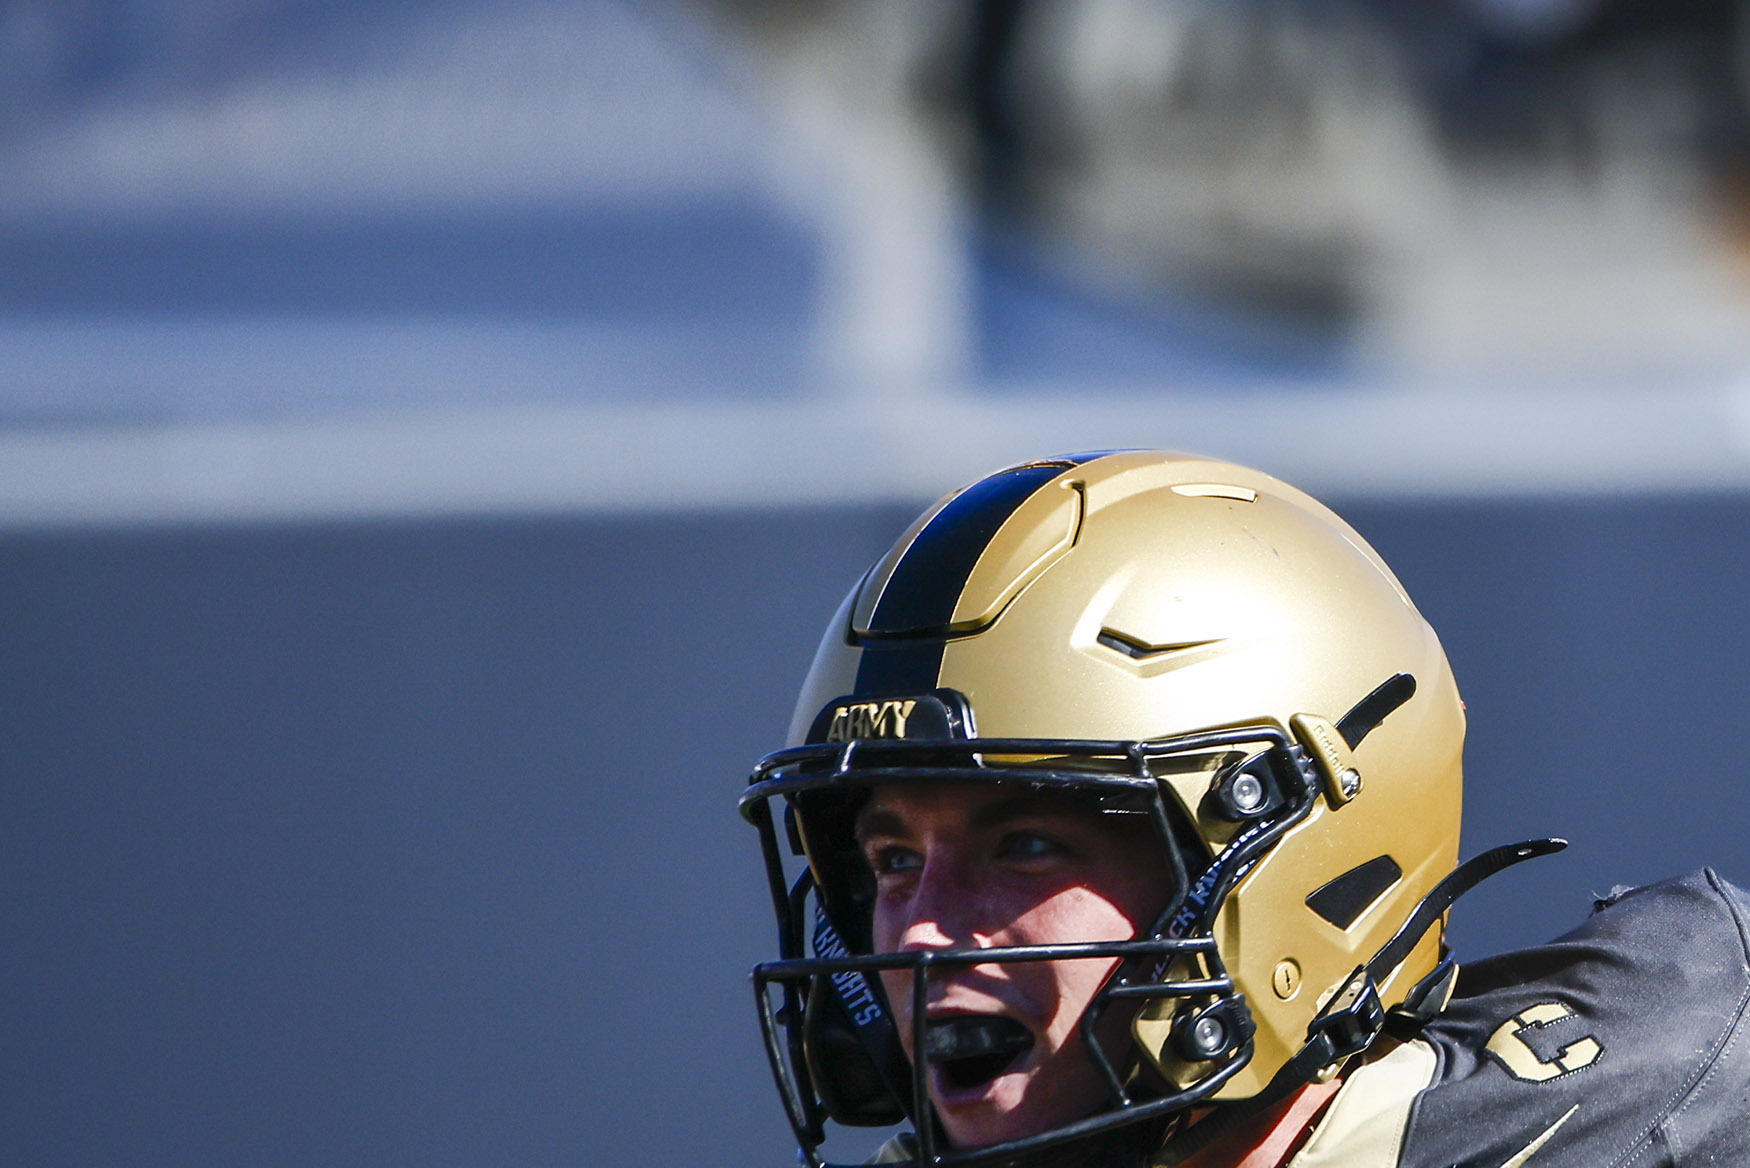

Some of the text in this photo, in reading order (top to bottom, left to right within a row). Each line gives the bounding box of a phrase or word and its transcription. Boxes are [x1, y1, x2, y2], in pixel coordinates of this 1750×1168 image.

[827, 700, 917, 742] ARMY
[815, 925, 882, 1027] KNGHTS
[1484, 1002, 1606, 1086] C
